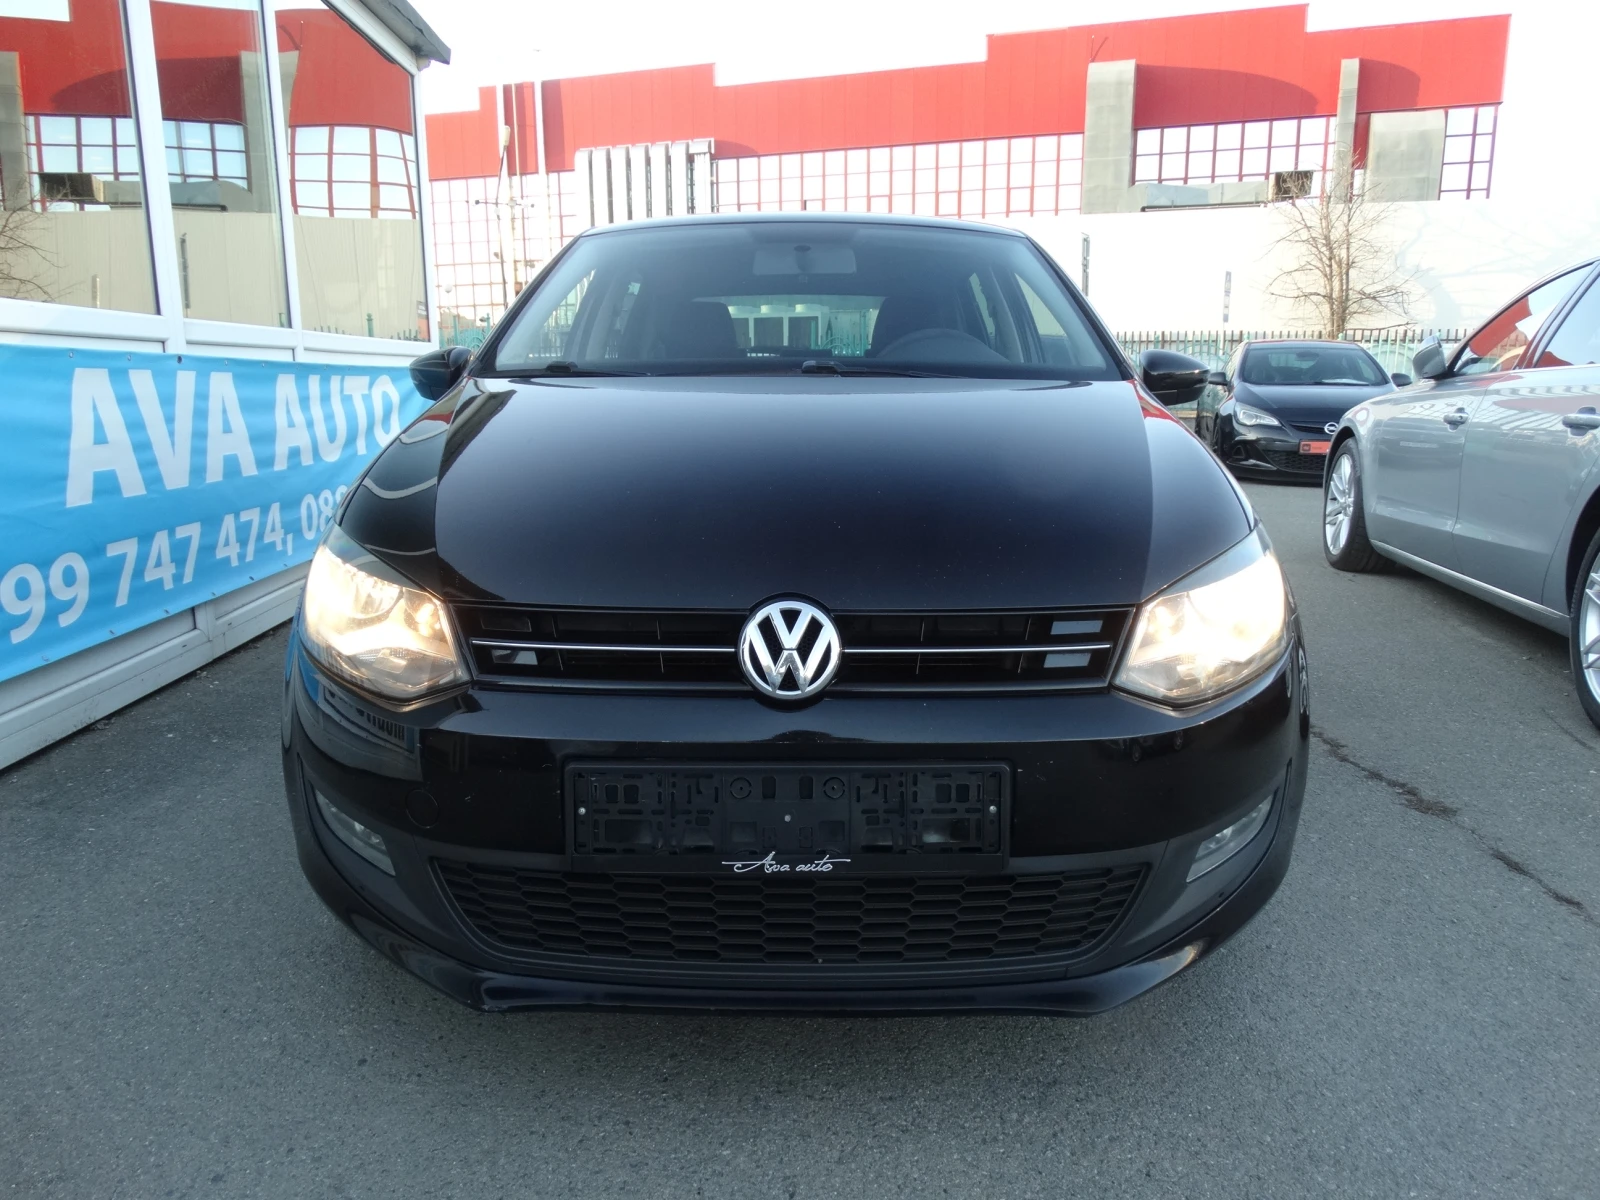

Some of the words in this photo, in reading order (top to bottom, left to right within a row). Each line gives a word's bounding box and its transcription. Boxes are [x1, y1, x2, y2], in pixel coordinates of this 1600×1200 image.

[66, 367, 258, 507] AVA
[274, 373, 400, 470] AUTO
[0, 552, 90, 644] 99
[106, 521, 200, 607] 747
[215, 502, 293, 567] 474,
[795, 855, 851, 872] auto
